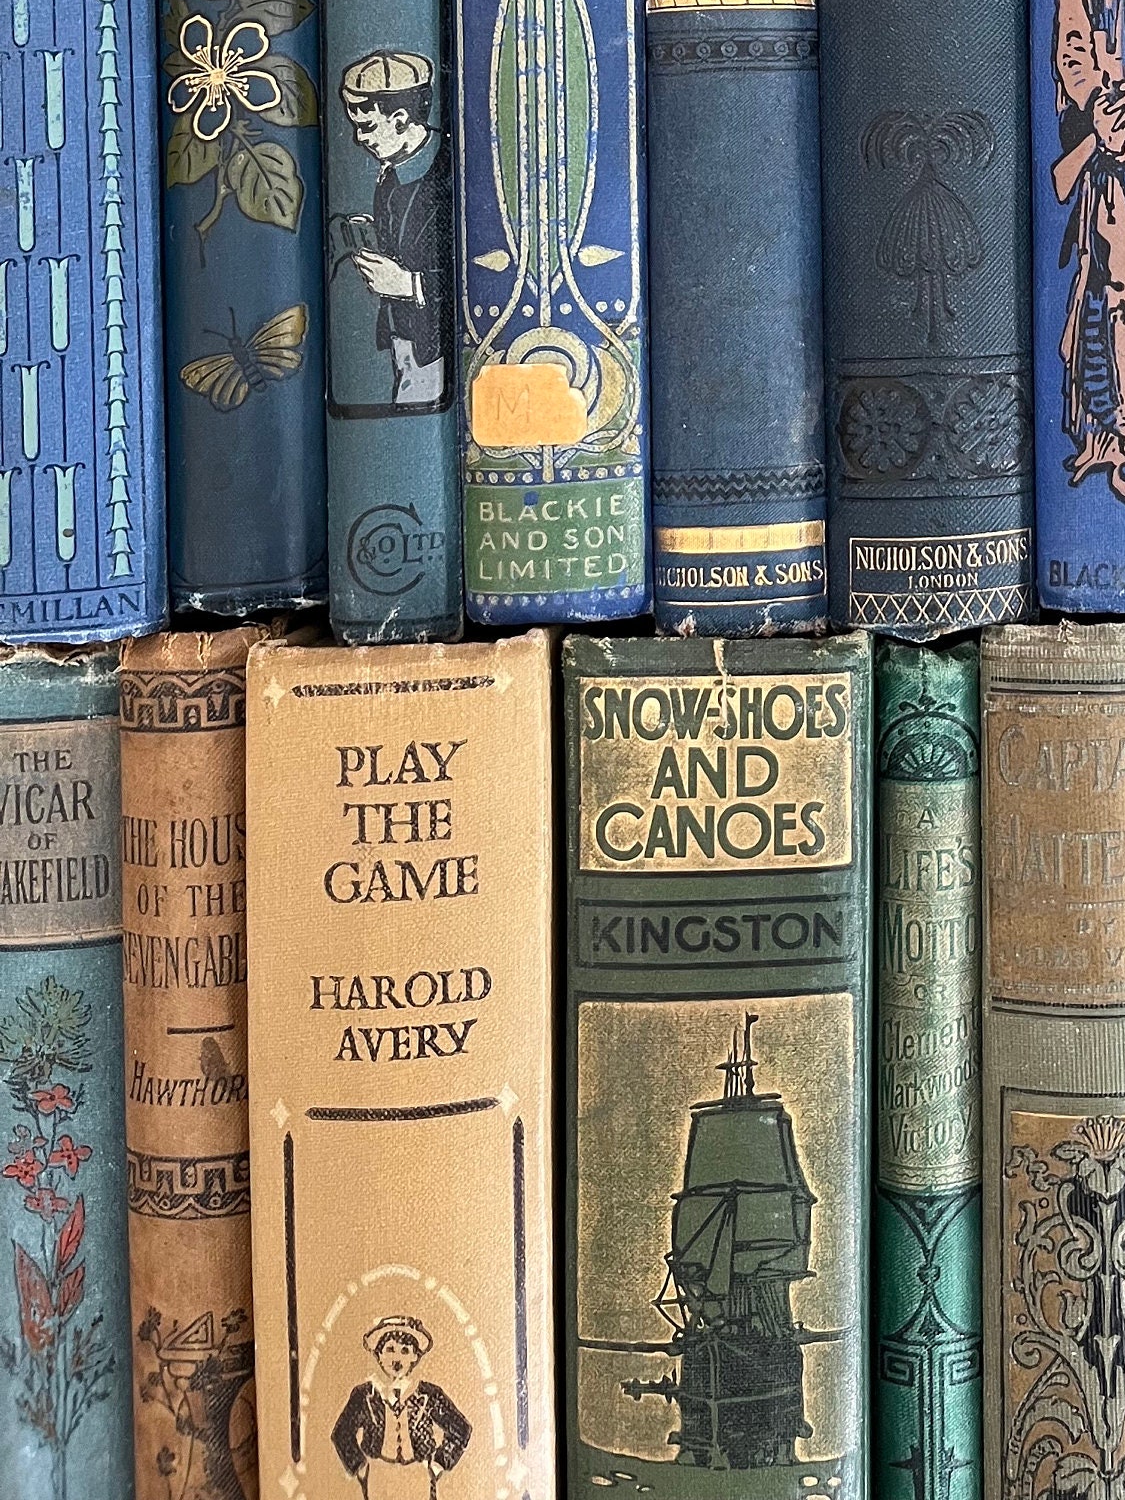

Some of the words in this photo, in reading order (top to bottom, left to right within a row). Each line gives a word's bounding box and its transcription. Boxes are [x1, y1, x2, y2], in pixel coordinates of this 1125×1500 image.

[479, 495, 625, 522] BLACKIE
[480, 532, 548, 551] AND
[563, 525, 624, 550] SON
[855, 544, 962, 572] NICHOLSON
[967, 542, 982, 568] &
[985, 538, 1029, 565] SONS
[479, 553, 627, 582] LIMITED
[754, 565, 774, 586] &
[775, 559, 824, 585] SONS
[908, 572, 979, 591] LONDON
[13, 749, 73, 773] THE
[335, 738, 468, 789] PLAY
[650, 746, 779, 799] AND
[28, 833, 58, 850] OF
[122, 815, 158, 868] THE
[342, 798, 453, 846] THE
[596, 800, 827, 860] CANOES
[916, 808, 938, 830] A
[0, 853, 110, 905] AKEFIELD
[323, 855, 480, 904] GAME
[883, 834, 976, 895] LIFE'S
[137, 882, 168, 917] OF
[186, 879, 247, 918] THE
[592, 911, 843, 956] KINGSTON
[882, 902, 977, 974] MOTTO
[309, 966, 493, 1012] HAROLD
[334, 1018, 478, 1062] AVERY
[889, 1101, 973, 1157] Victory
